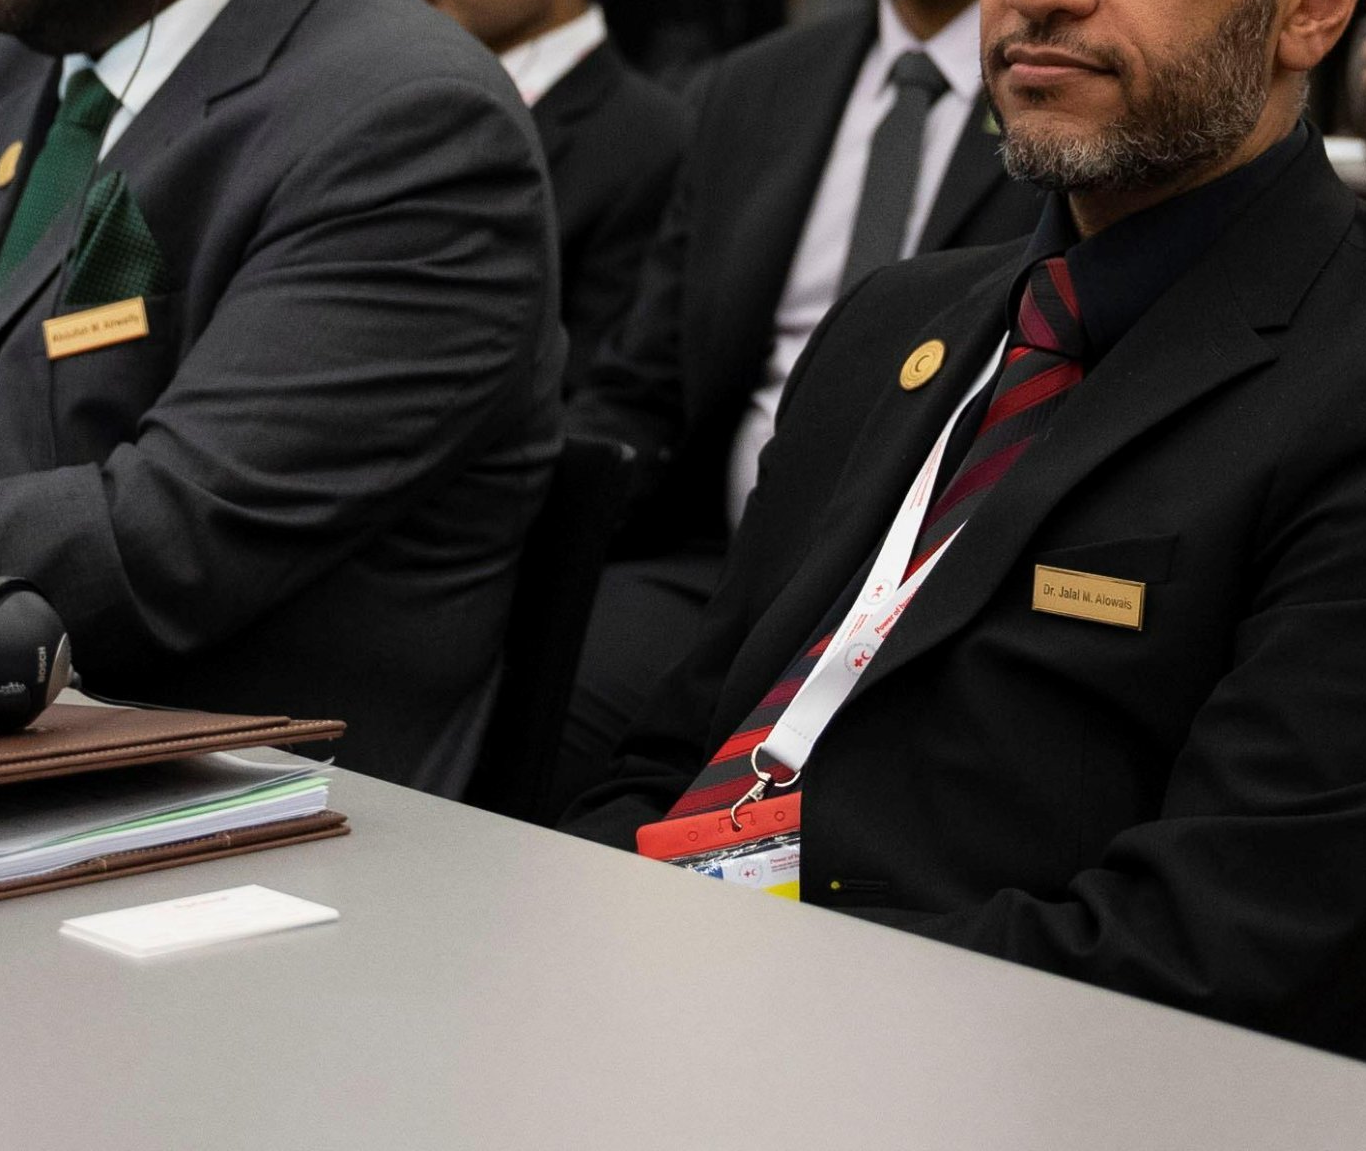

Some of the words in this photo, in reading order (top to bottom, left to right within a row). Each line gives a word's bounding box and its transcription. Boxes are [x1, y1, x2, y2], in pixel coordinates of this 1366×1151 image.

[1043, 582, 1056, 597] Dr.
[1059, 586, 1080, 601] Jalal
[1082, 591, 1093, 603] M.
[37, 646, 47, 683] BOSCH
